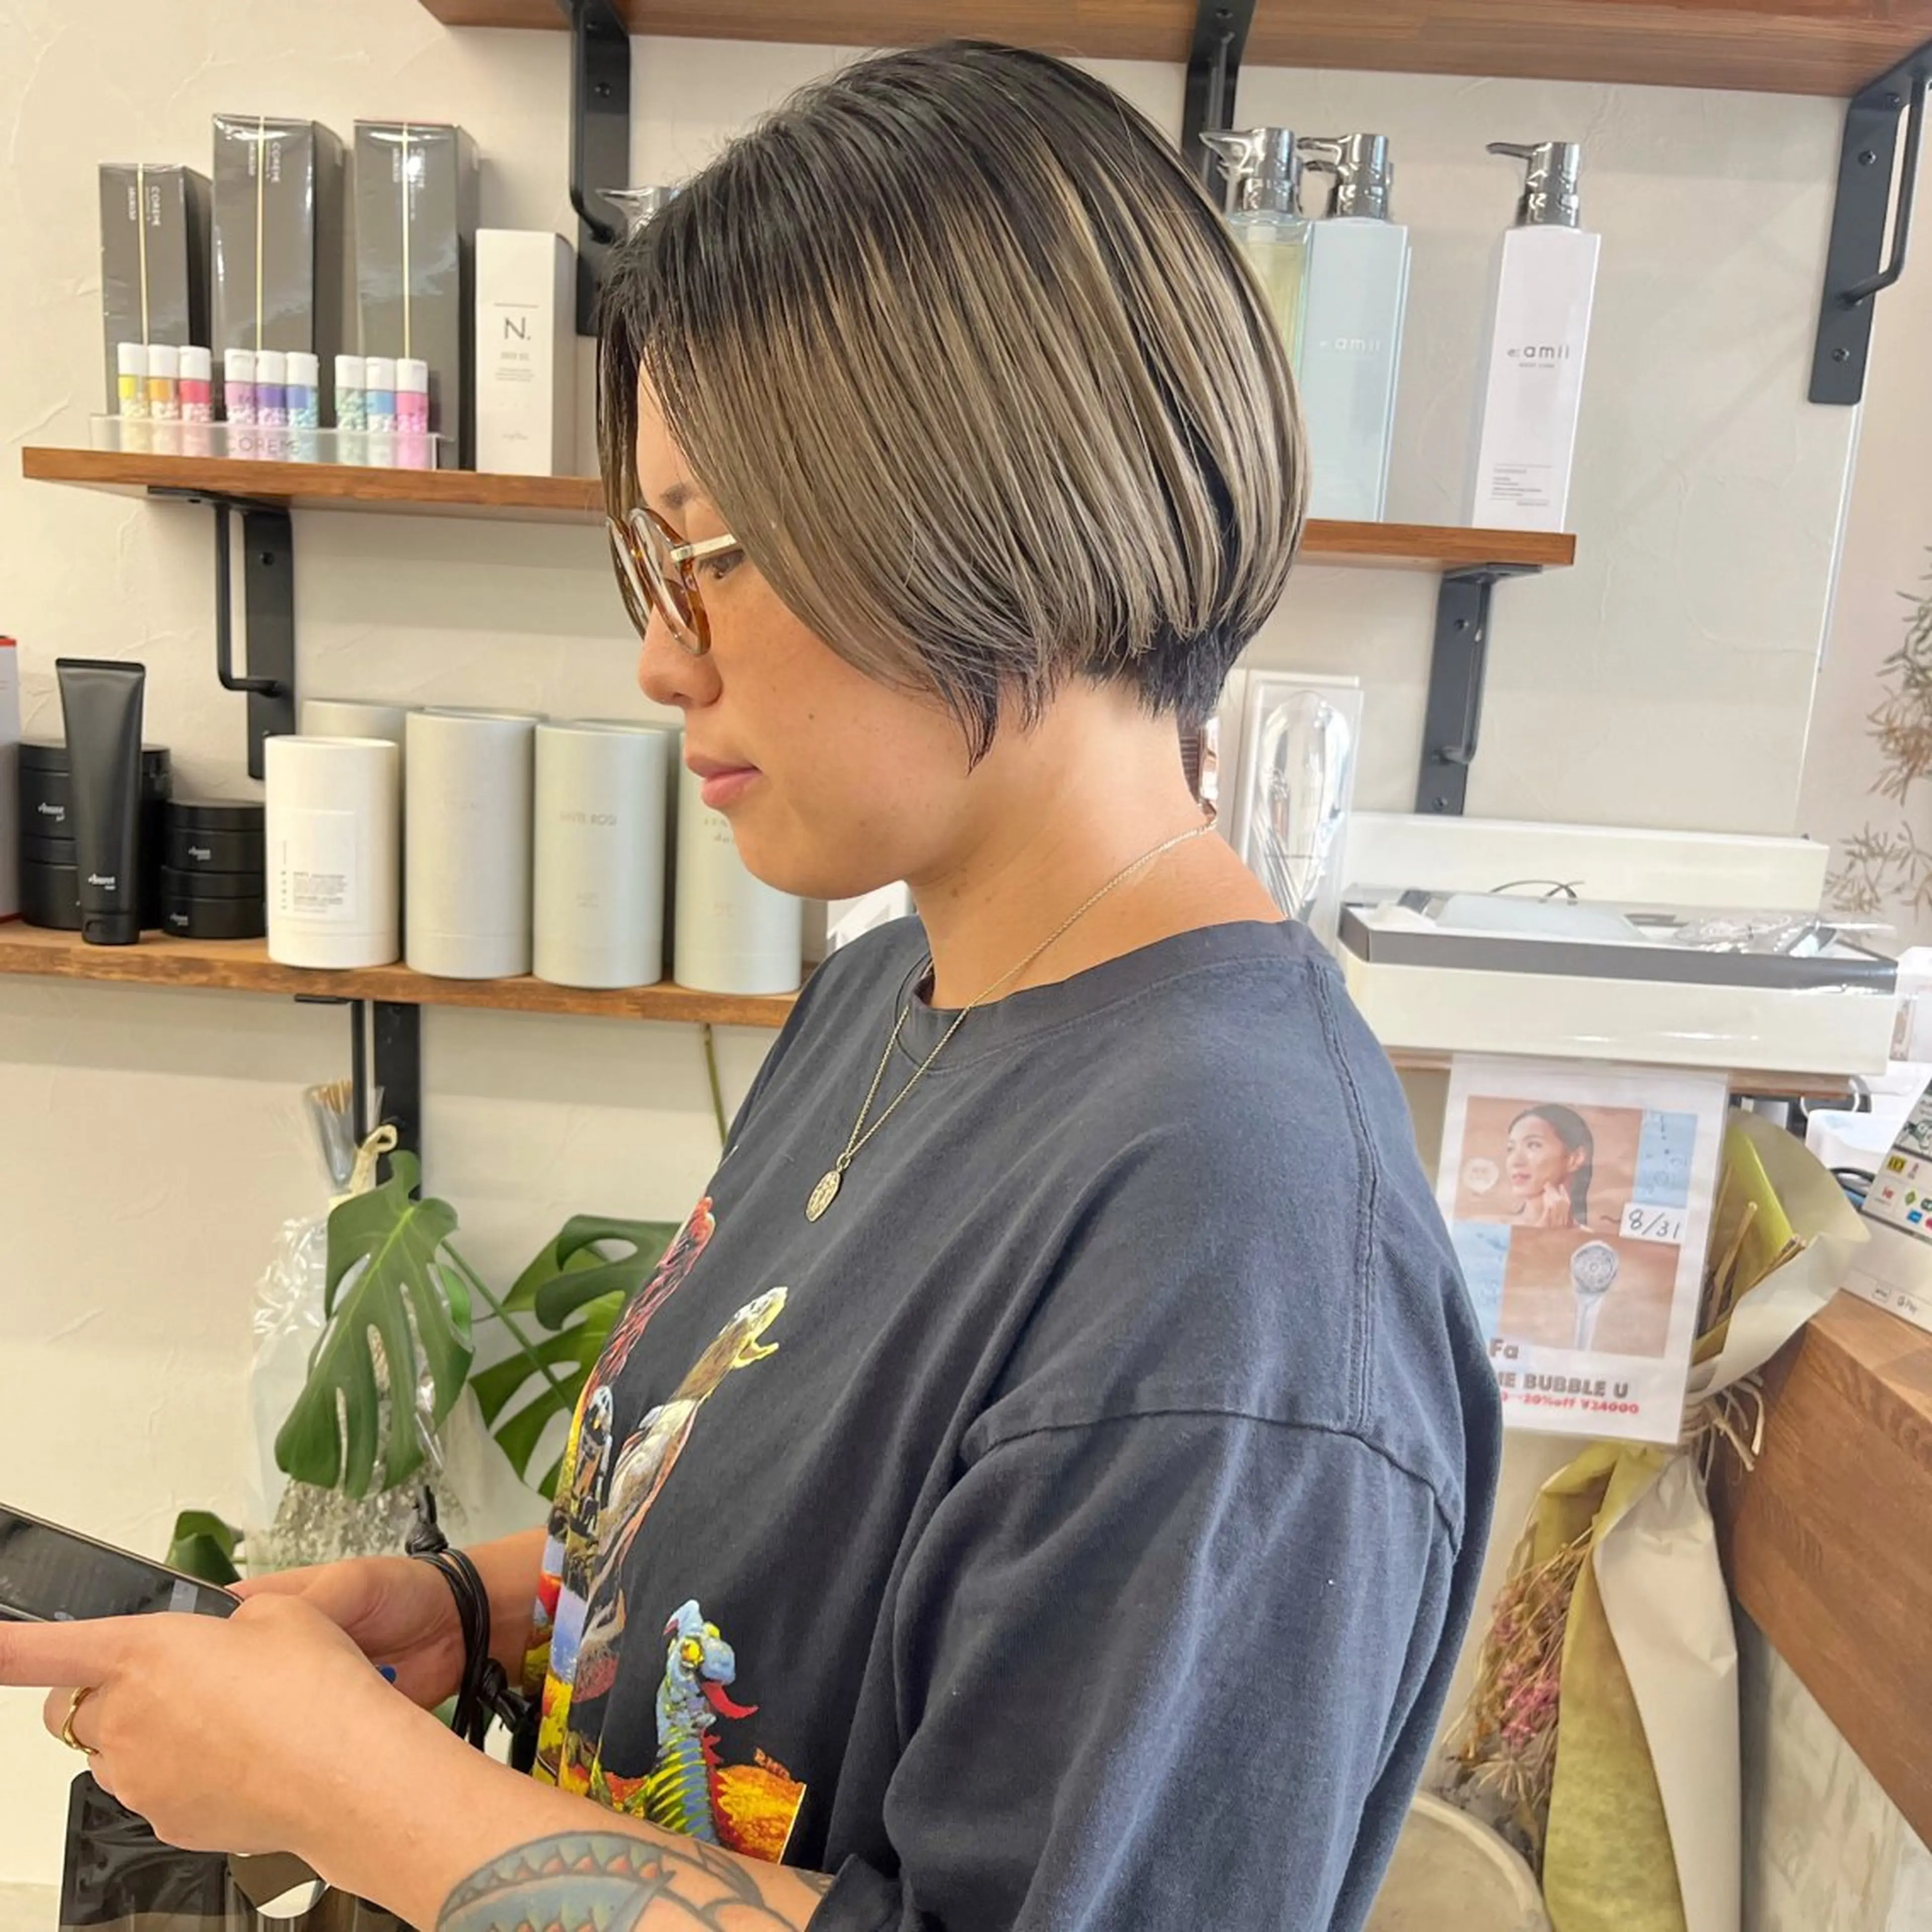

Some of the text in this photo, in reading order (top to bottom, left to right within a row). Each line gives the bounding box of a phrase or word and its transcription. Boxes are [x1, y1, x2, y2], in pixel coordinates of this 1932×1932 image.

[1629, 1208, 1680, 1239] 8/31
[1522, 1373, 1606, 1397] BUBBLE
[1613, 1382, 1628, 1399] U
